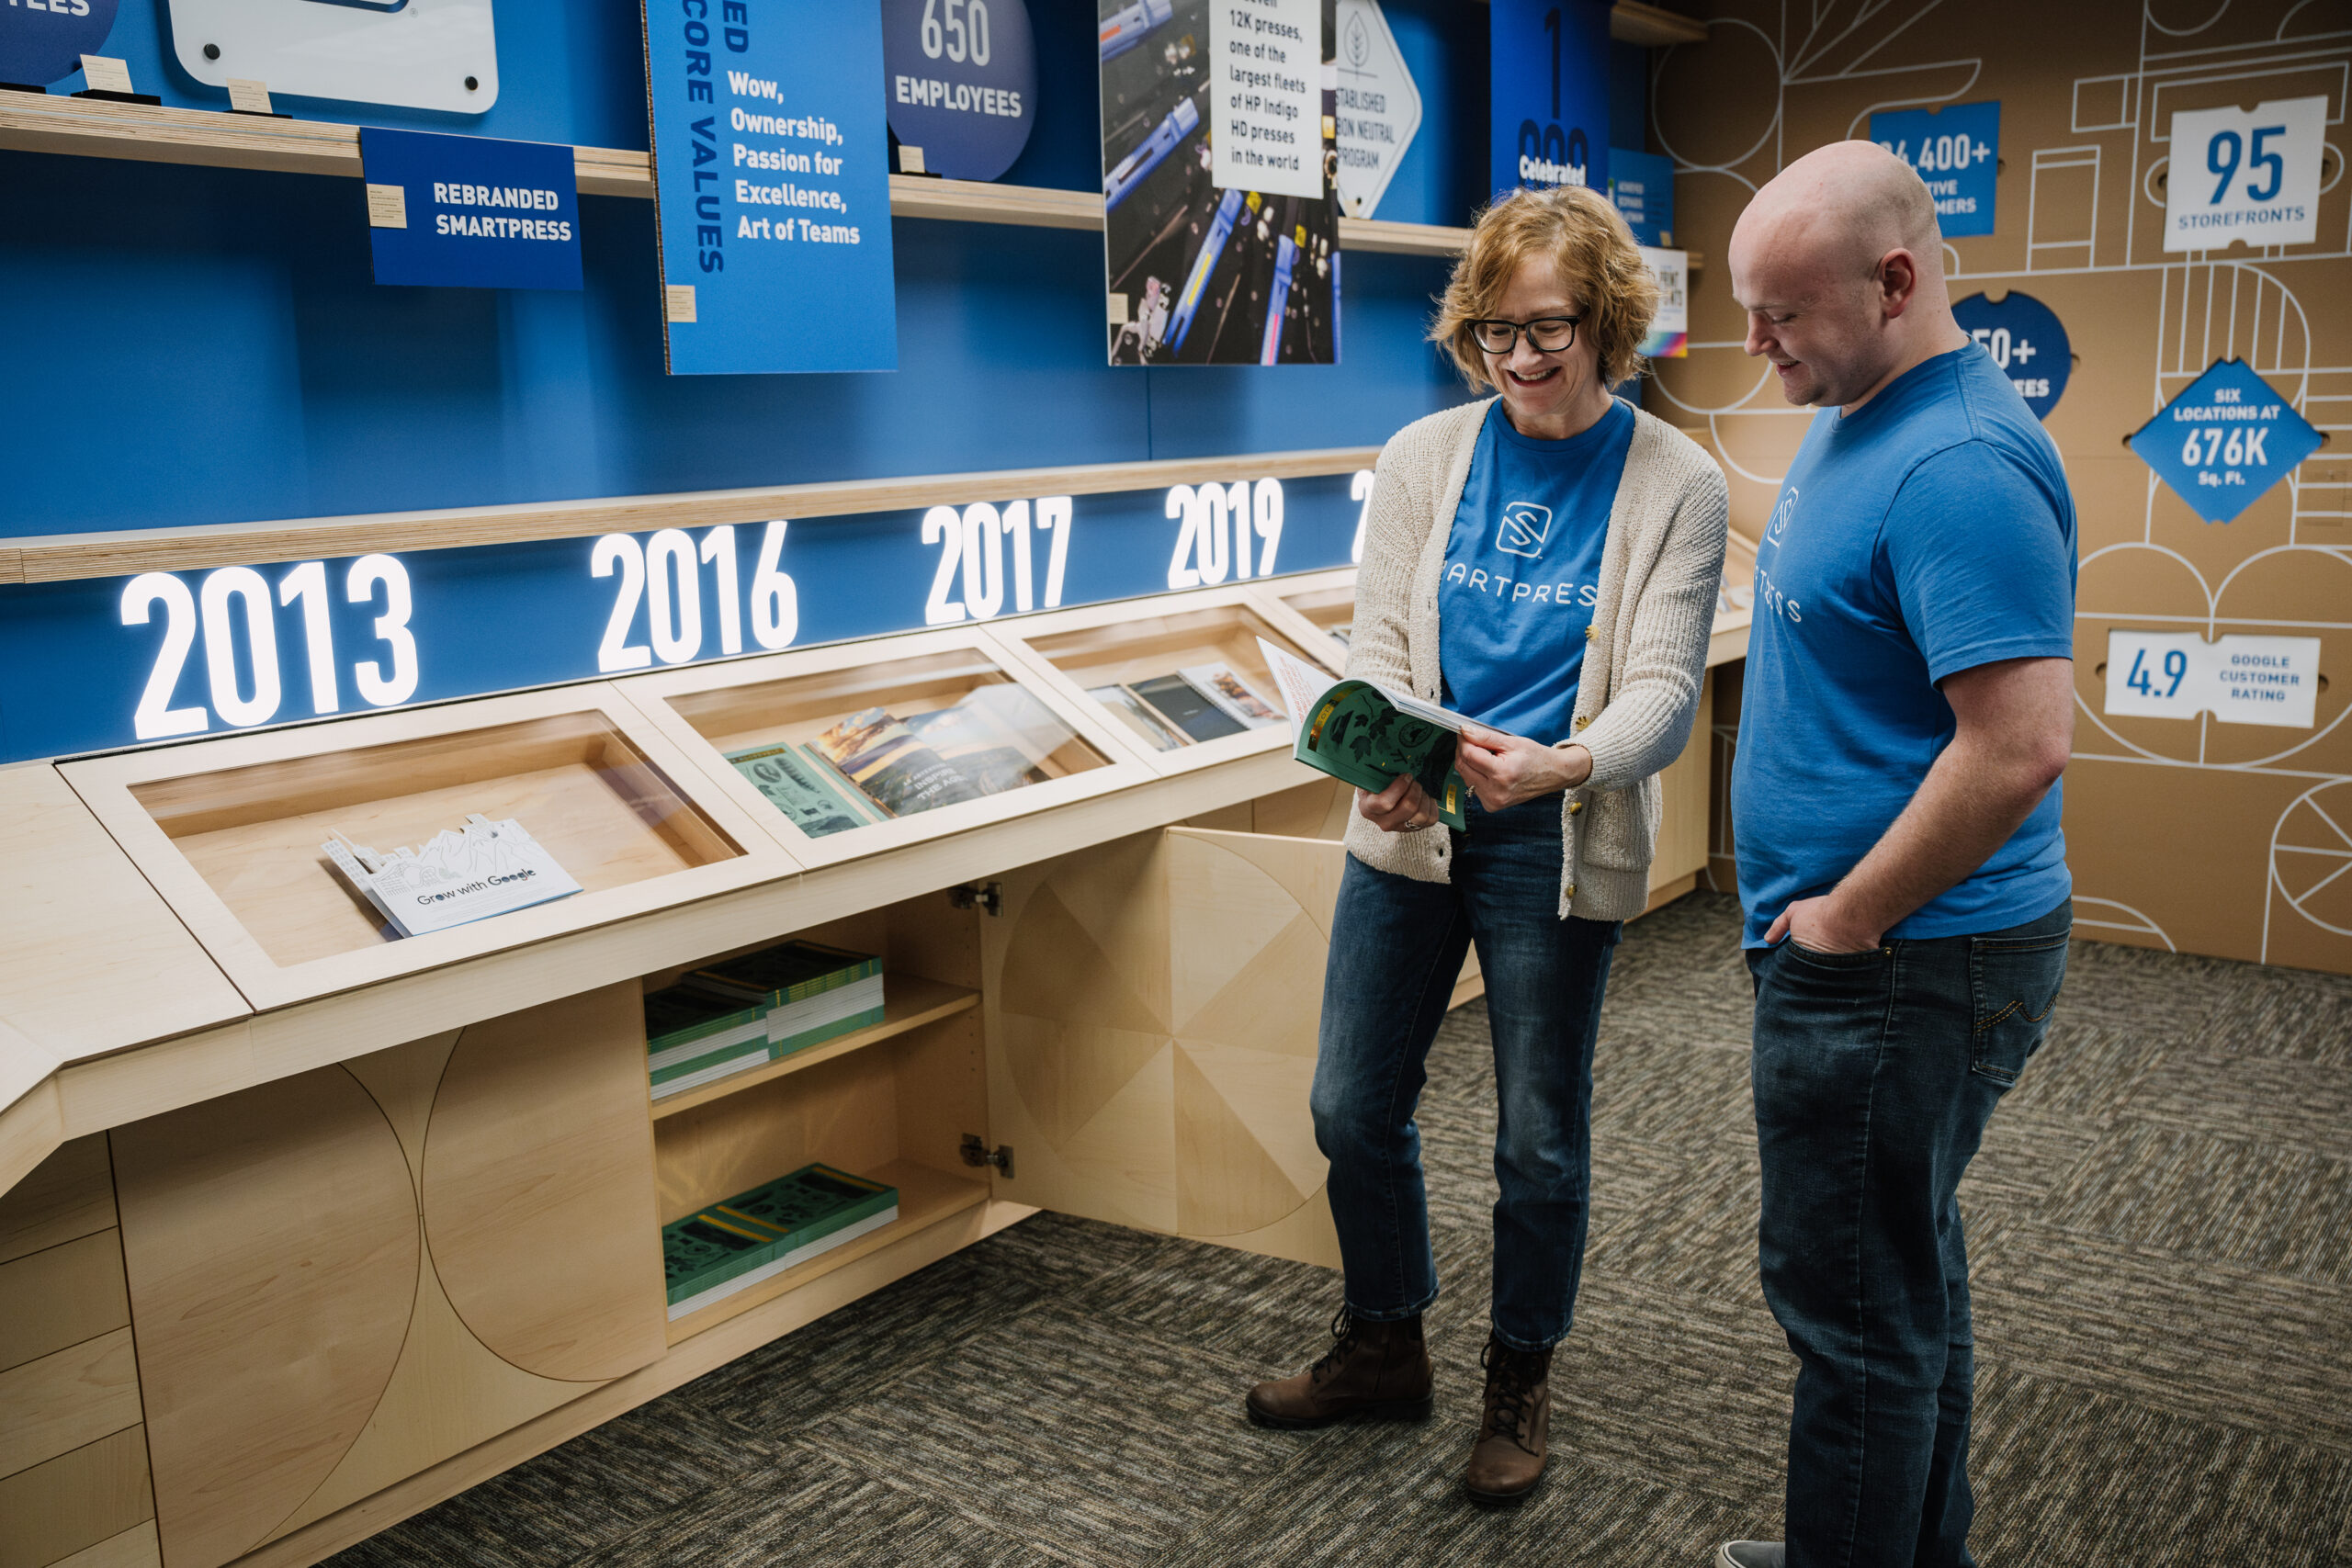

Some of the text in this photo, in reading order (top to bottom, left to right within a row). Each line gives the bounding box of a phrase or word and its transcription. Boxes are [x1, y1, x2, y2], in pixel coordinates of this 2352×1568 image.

[921, 0, 990, 67] 650
[1230, 9, 1303, 43] 12K presses,
[1229, 40, 1286, 63] one of the
[727, 70, 784, 105] Wow,
[1229, 64, 1306, 94] largest fleets
[895, 74, 1023, 118] EMPLOYEES
[1230, 93, 1298, 121] of HP Indigo
[1336, 87, 1385, 114] STABLISHED
[683, 0, 724, 274] CORE VALUES
[730, 107, 843, 146] Ownership,
[1230, 119, 1295, 143] HD presses
[1336, 116, 1396, 144] BON NEUTRAL
[732, 142, 843, 176] Passion for
[1231, 147, 1299, 171] in the world
[1519, 153, 1587, 186] Celebrated
[2207, 124, 2286, 206] 95
[434, 182, 559, 211] REBRANDED
[735, 179, 847, 214] Excellence,
[1926, 178, 1958, 197] TIVE
[1934, 197, 1977, 215] MERS
[2178, 205, 2306, 230] STOREFRONTS
[435, 213, 572, 242] SMARTPRESS
[737, 214, 861, 244] Art of Teams
[1972, 327, 2037, 369] 50+
[2214, 387, 2241, 403] SIX
[2173, 404, 2281, 422] LOCATIONS AT
[2181, 426, 2269, 467] 676K
[2198, 470, 2245, 488] Sq. Ft.
[1165, 476, 1284, 590] 2019
[922, 495, 1073, 626] 2017
[591, 520, 798, 673] 2016
[1442, 560, 1598, 607] ARTPRES
[120, 553, 419, 740] 2013
[2231, 653, 2290, 669] GOOGLE
[2126, 648, 2188, 698] 4.9
[2220, 670, 2301, 687] CUSTOMER
[2231, 686, 2286, 703] RATING
[417, 868, 537, 906] Grow with Google
